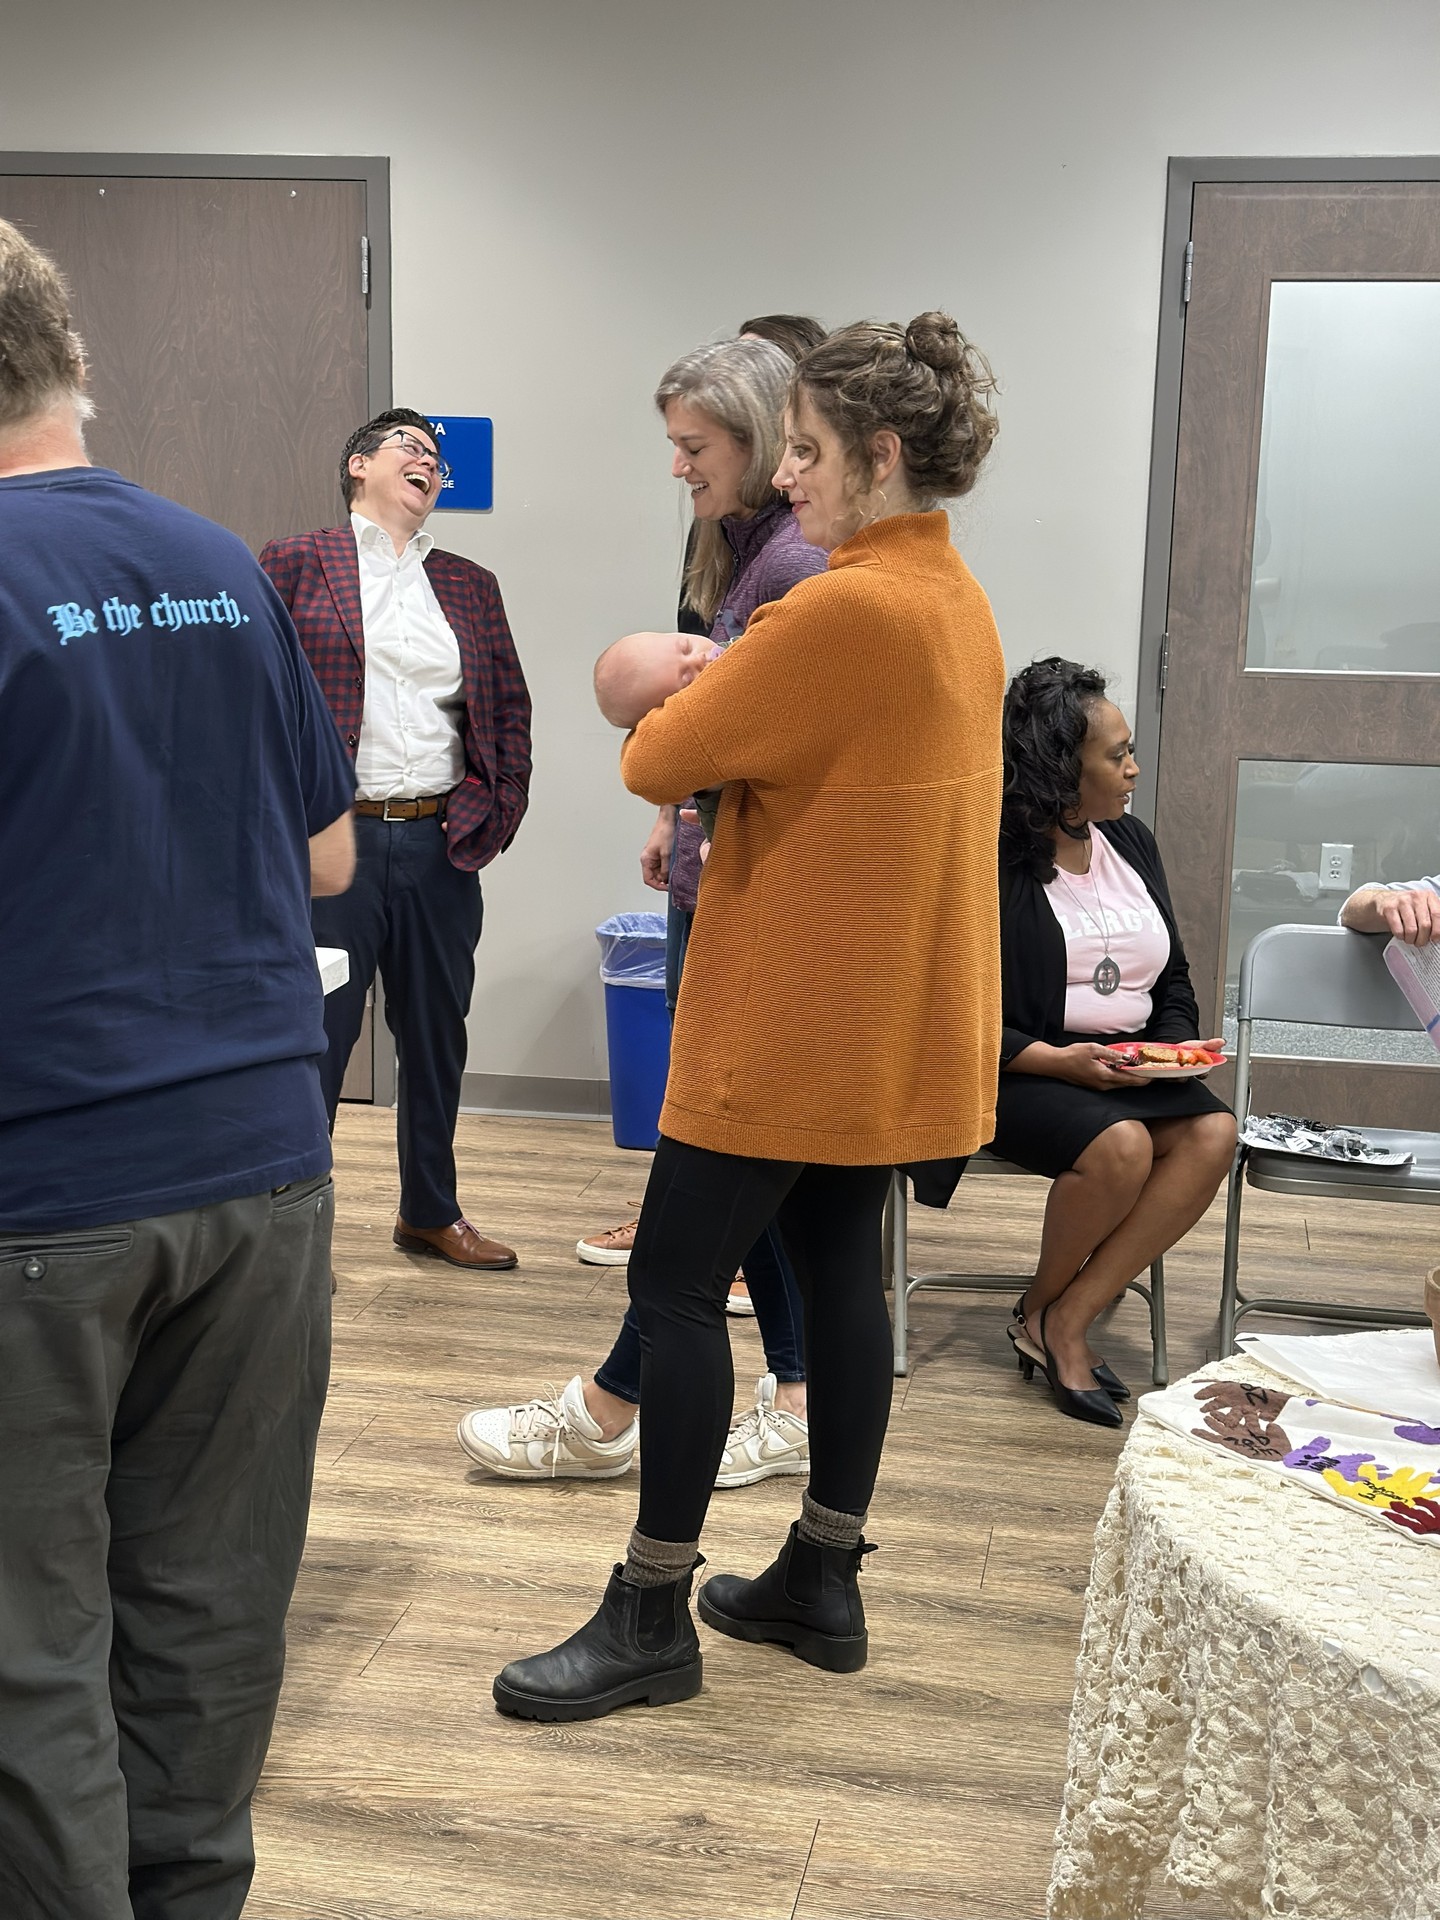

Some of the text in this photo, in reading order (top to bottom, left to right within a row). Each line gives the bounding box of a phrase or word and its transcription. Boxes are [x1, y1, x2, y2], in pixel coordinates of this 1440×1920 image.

[441, 480, 455, 488] GE
[47, 591, 250, 646] Be the church.
[1058, 908, 1161, 940] LERGY
